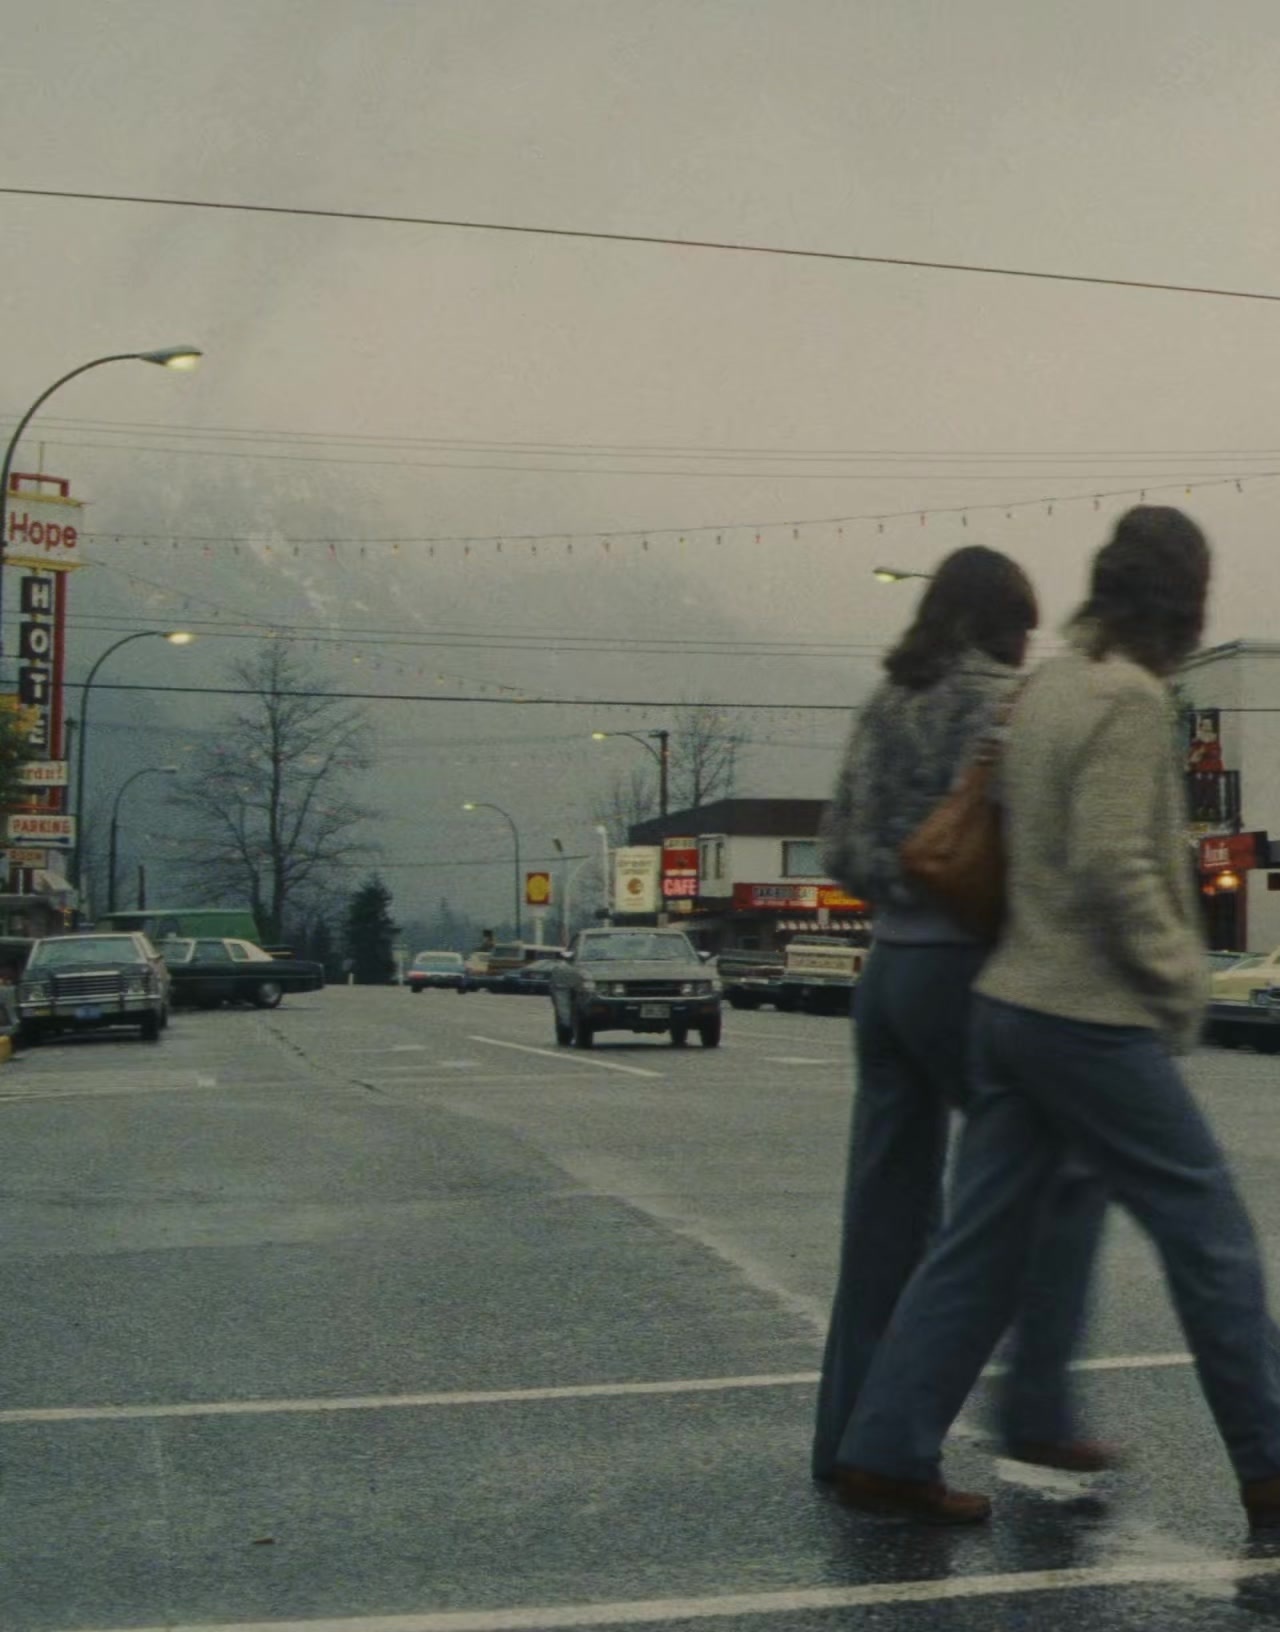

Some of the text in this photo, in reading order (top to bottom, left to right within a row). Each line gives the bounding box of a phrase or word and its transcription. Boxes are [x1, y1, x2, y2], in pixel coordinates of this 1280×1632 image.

[8, 511, 77, 552] Hope
[12, 819, 71, 833] PARKING
[663, 878, 697, 896] CAFE
